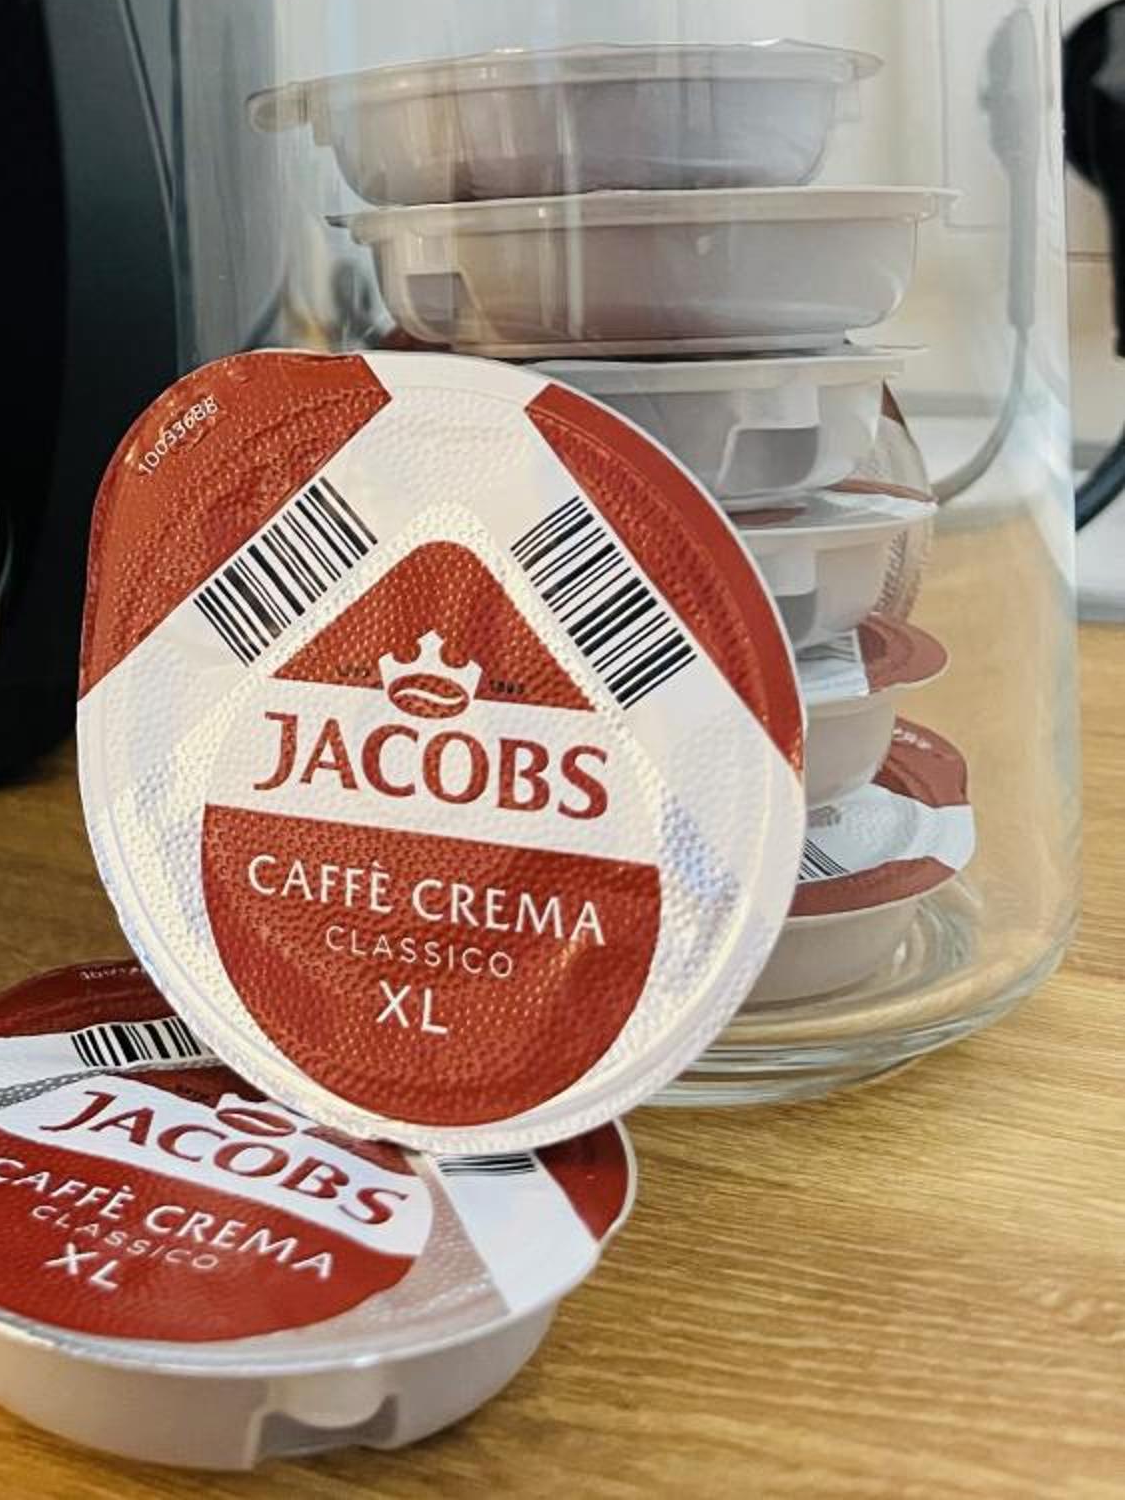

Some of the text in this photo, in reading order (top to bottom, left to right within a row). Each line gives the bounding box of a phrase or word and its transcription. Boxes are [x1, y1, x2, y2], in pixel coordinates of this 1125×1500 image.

[138, 394, 218, 475] 10033688
[253, 711, 609, 820] JACOBS
[248, 854, 606, 947] CAFFÈ CREMA
[325, 925, 513, 979] CLASSICO
[376, 979, 448, 1035] XL
[39, 1090, 409, 1225] JACOBS
[31, 1204, 220, 1270] CLASSICO
[44, 1242, 122, 1290] XL
[144, 1204, 336, 1280] CREMA
